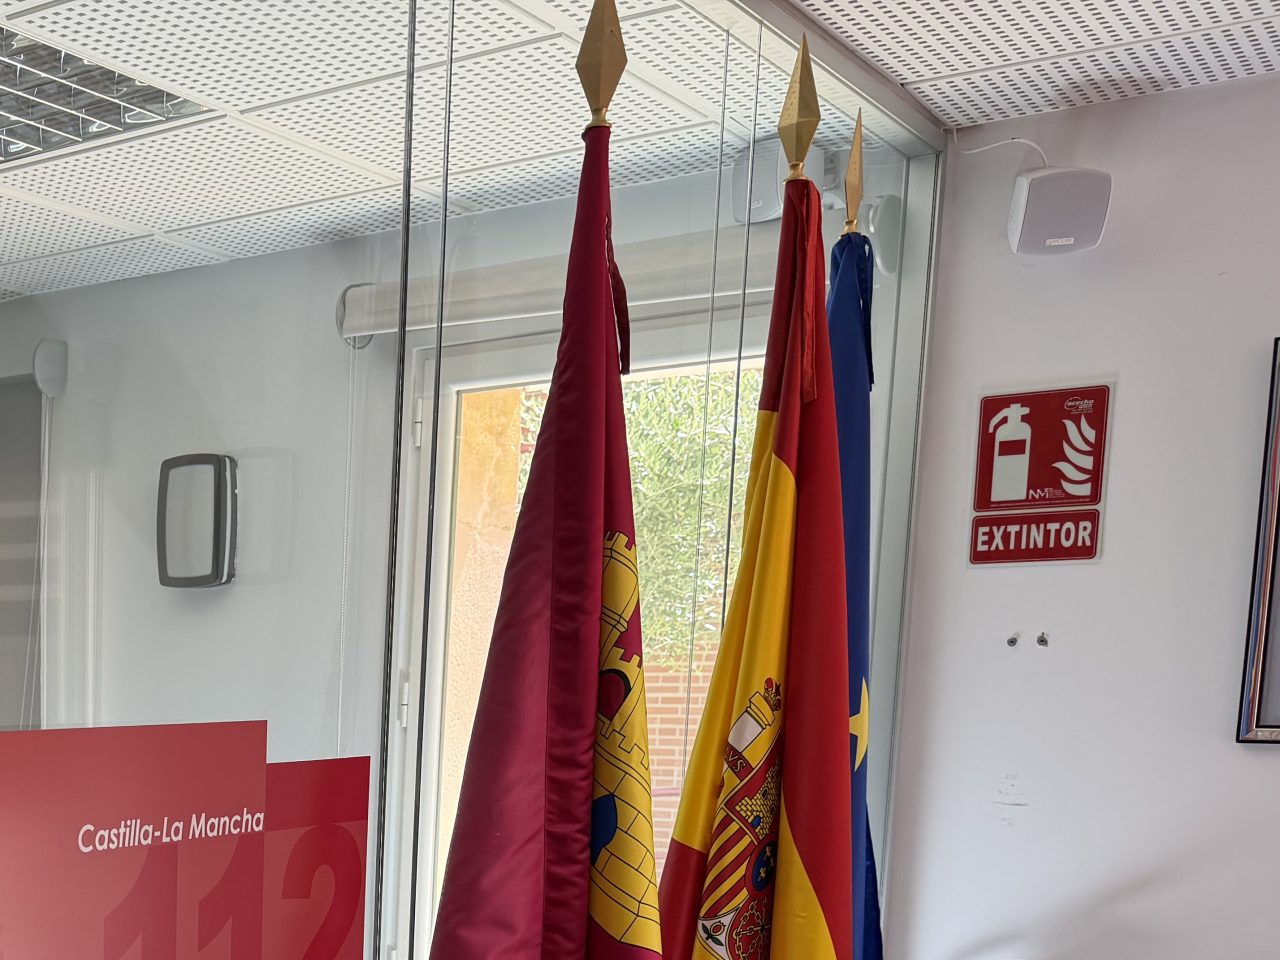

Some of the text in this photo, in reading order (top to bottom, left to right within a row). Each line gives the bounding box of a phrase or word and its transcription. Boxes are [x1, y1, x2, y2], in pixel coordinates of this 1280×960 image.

[976, 519, 1093, 552] EXTINTOR
[77, 807, 265, 854] Castilla-La Mancha
